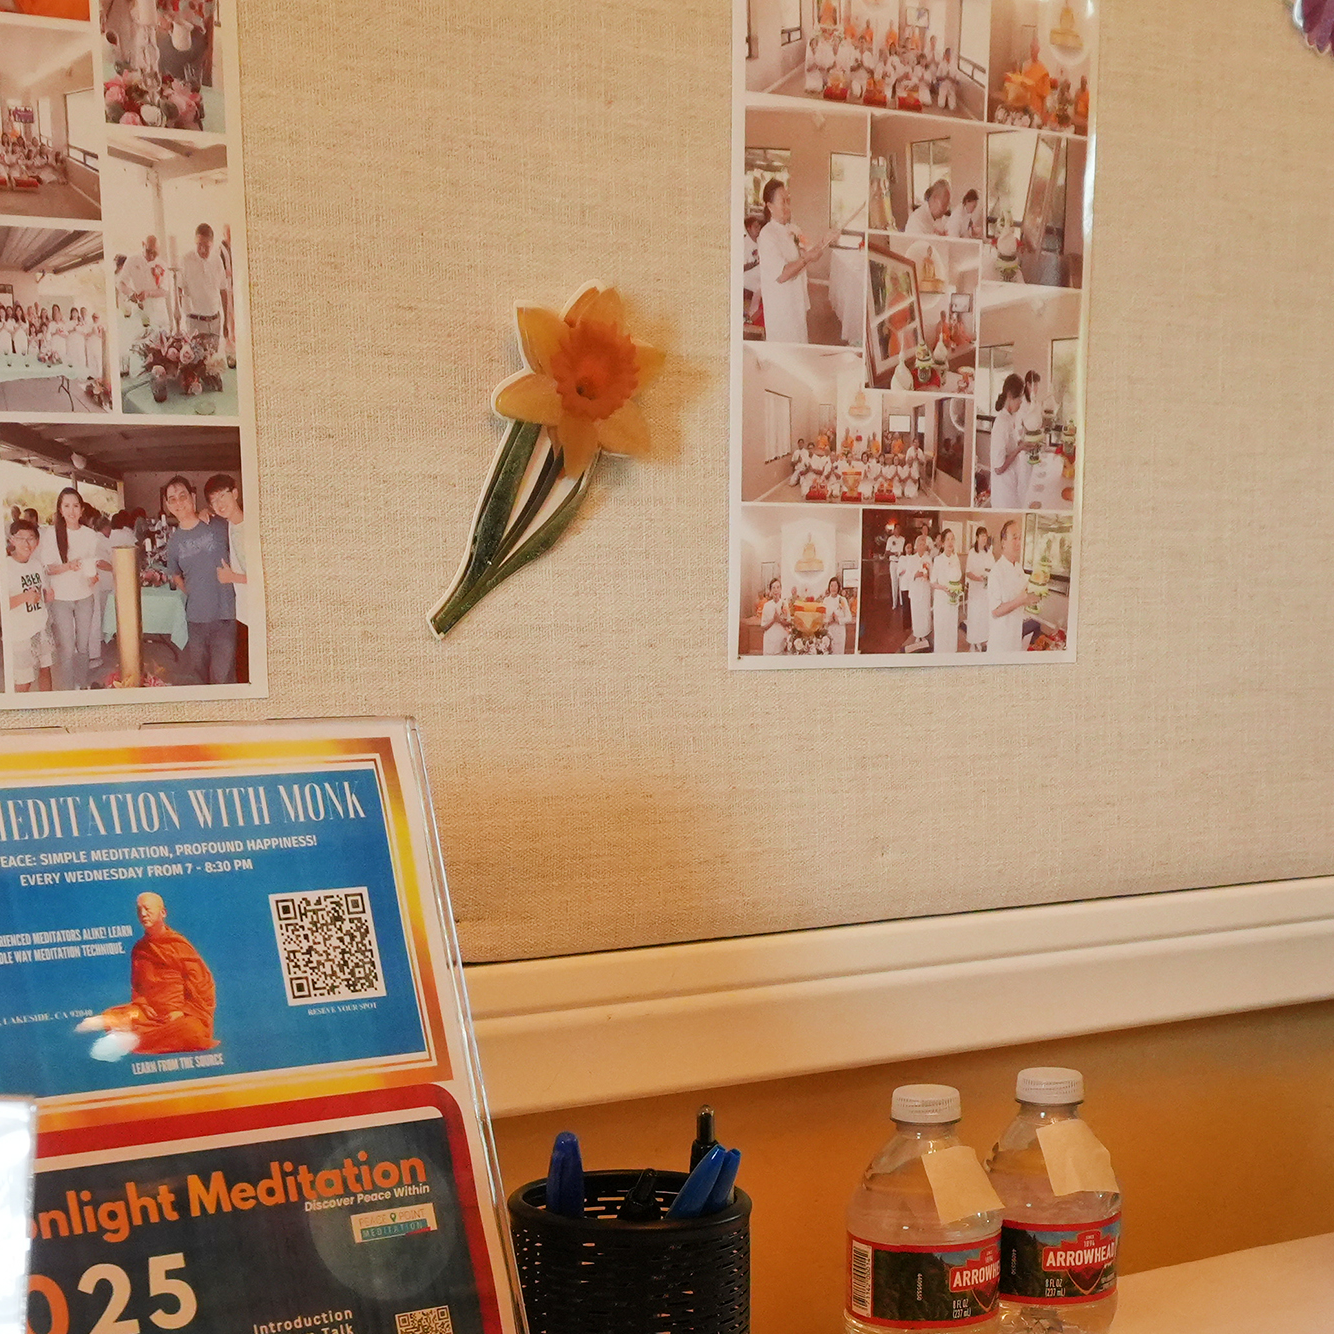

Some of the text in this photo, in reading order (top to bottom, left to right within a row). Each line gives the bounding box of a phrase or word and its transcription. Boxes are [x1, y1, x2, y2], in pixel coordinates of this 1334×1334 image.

[187, 784, 270, 829] WITH
[276, 780, 367, 824] MONK
[40, 850, 88, 865] SIMPLE
[91, 845, 174, 862] MEDITATION,
[175, 840, 244, 856] PROFOUND
[247, 834, 317, 850] HAPPINESS!
[20, 873, 61, 887] EVERY
[65, 867, 144, 884] WEDNESDAY
[147, 863, 184, 878] FROM
[185, 862, 193, 875] 7
[205, 860, 231, 874] 8:30
[234, 858, 254, 871] PM
[33, 929, 82, 945] MEDITATORS
[83, 927, 107, 941] ALIKE!
[108, 925, 133, 938] LEARN
[15, 950, 33, 964] WAY
[34, 946, 82, 962] MEDITATION
[337, 1003, 359, 1013] YOUR
[359, 1001, 378, 1011] SPOT
[131, 1053, 224, 1075] LEARN FROM THE SOURCE
[187, 1150, 427, 1218] Meditation
[304, 1184, 430, 1212] Discover Peace Within
[358, 1208, 426, 1228] PEACE POINT
[361, 1221, 424, 1238] MEDITATION
